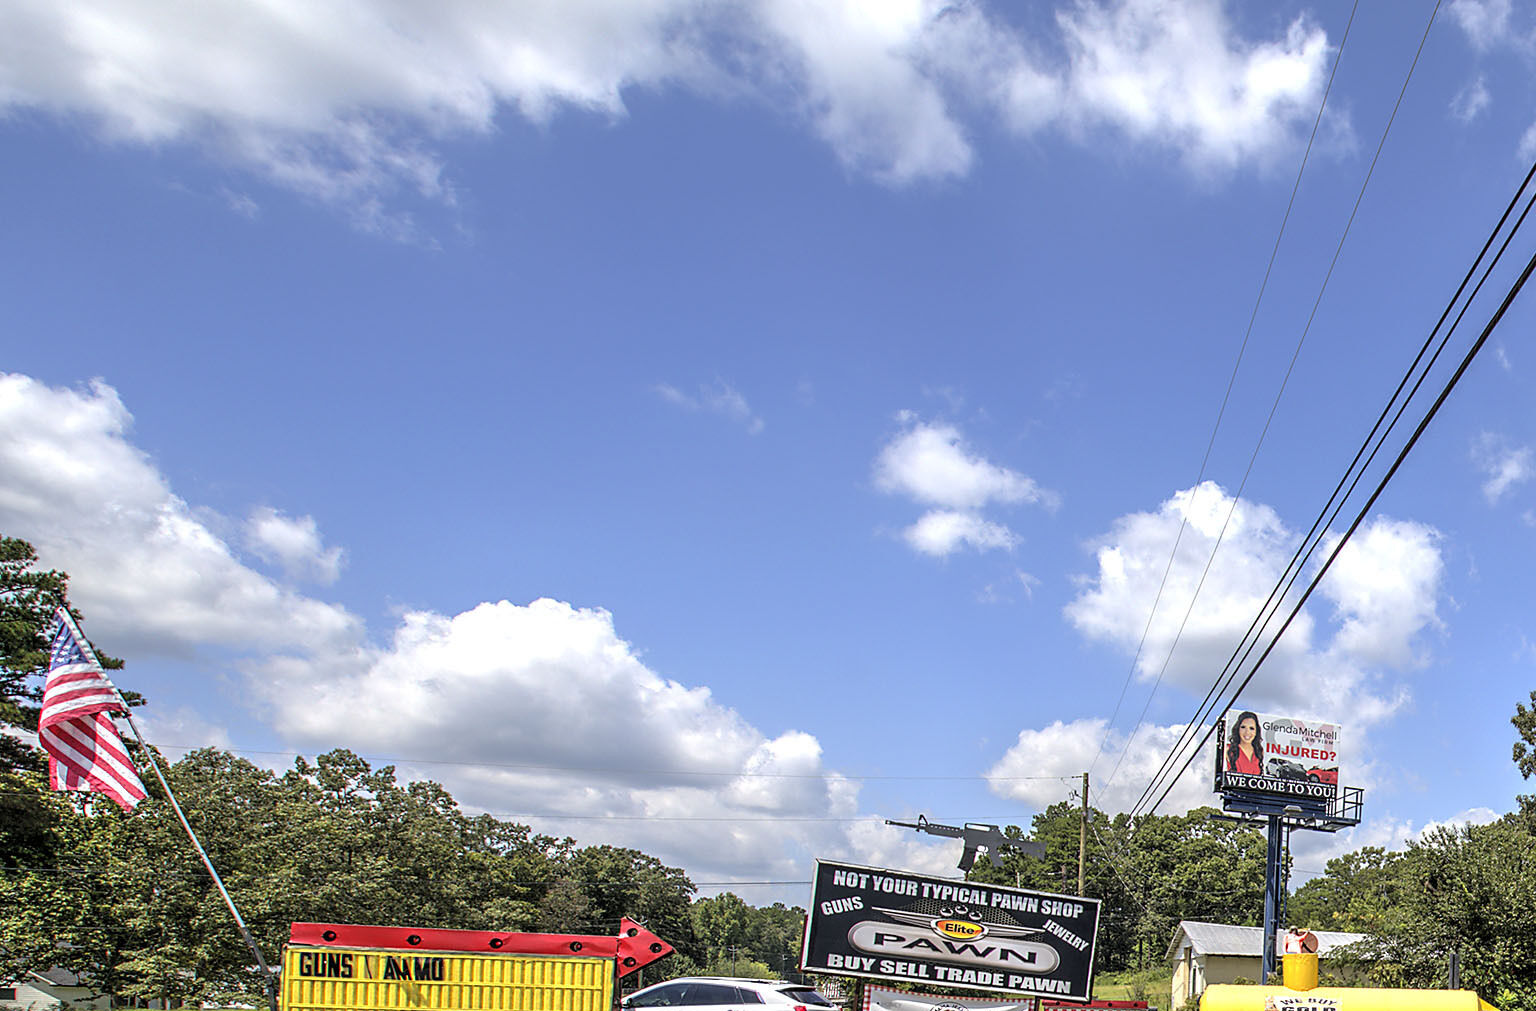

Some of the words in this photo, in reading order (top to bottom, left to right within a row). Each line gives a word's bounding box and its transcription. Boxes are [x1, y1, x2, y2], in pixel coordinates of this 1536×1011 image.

[1262, 721, 1298, 735] Glenda
[1299, 727, 1337, 740] Mitchell
[1266, 742, 1337, 762] INJURED?
[1226, 775, 1246, 787] WE
[1248, 778, 1285, 792] COME
[1287, 783, 1304, 794] TO
[1306, 785, 1336, 798] YOU!
[833, 869, 870, 890] NOT
[872, 875, 918, 896] YOUR
[922, 882, 988, 906] TYPICAL
[991, 892, 1039, 914] PAWN
[1041, 899, 1084, 918] SHOP
[820, 895, 864, 917] GUNS
[944, 922, 976, 935] Elite
[1042, 918, 1089, 952] JEWELRY
[873, 932, 1038, 965] PAWN
[300, 952, 353, 978] GUNS
[827, 953, 876, 972] BUY
[880, 960, 930, 978] SELL
[934, 966, 1004, 987] TRADE
[1008, 975, 1072, 995] PAWN
